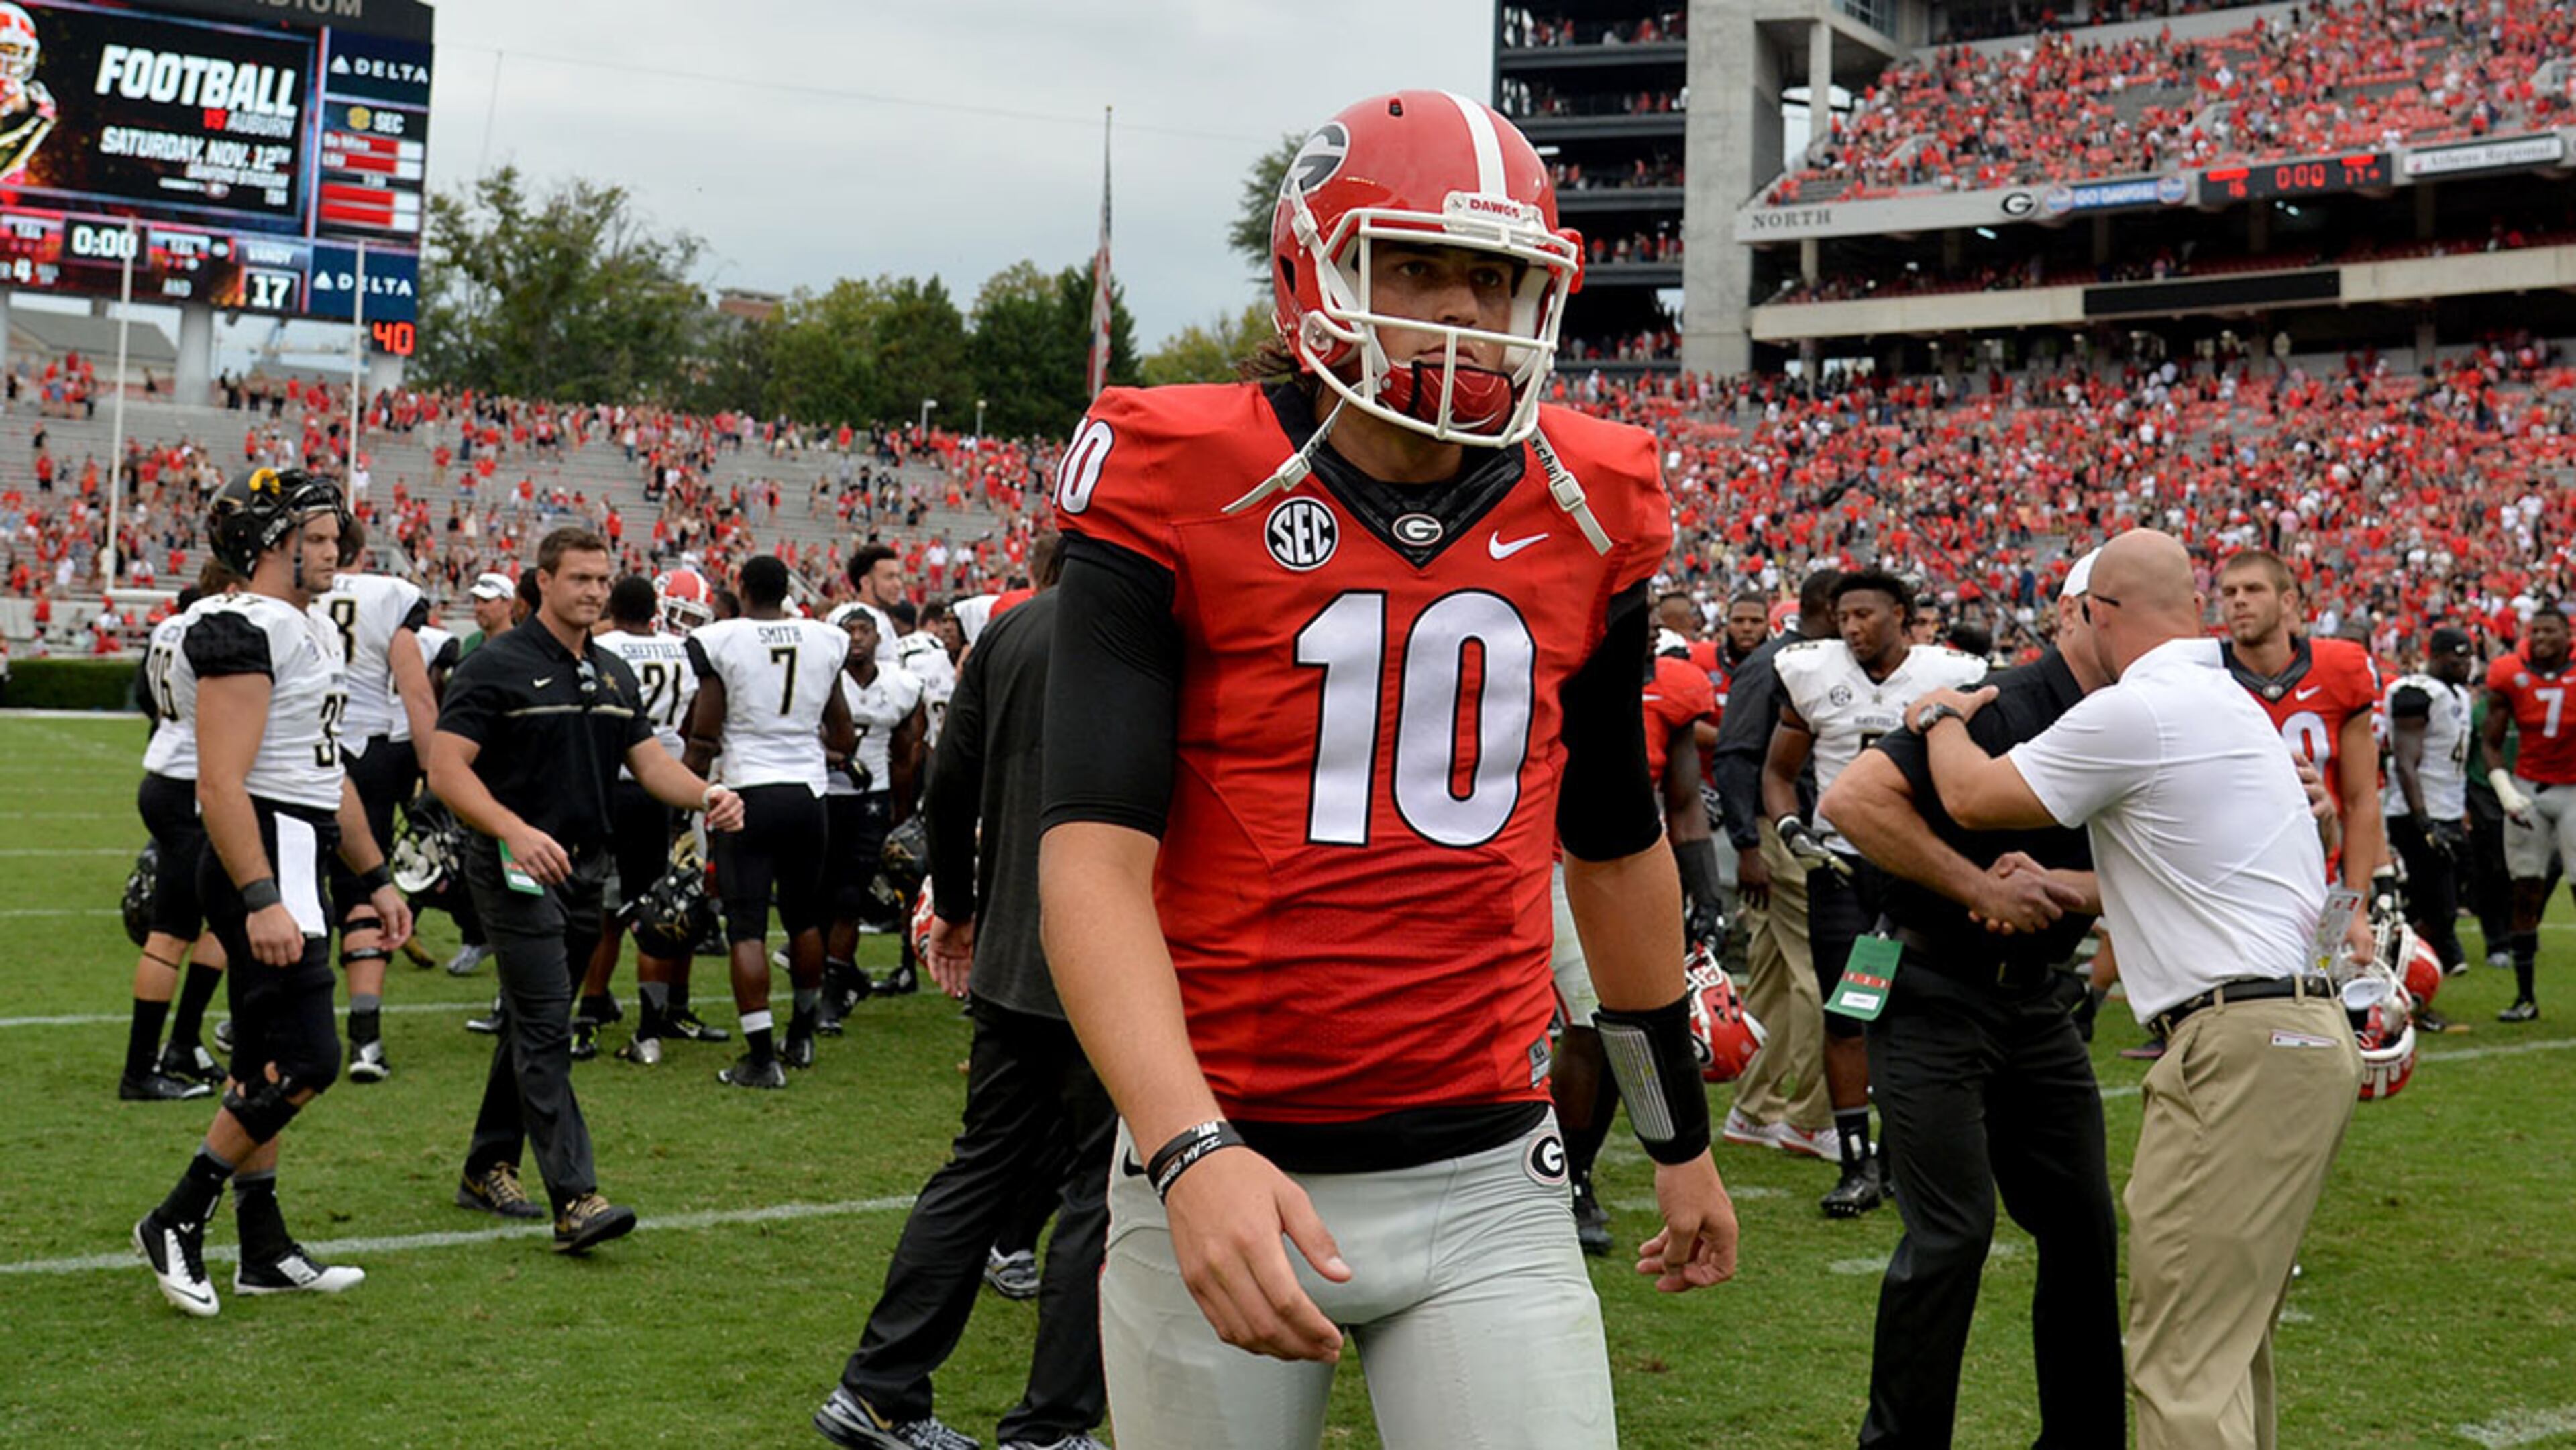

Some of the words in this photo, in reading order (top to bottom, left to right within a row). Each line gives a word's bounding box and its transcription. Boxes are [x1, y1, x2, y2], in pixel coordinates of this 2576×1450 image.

[95, 44, 297, 116] FOOTBALL
[354, 56, 428, 84] DELTA
[373, 111, 405, 134] SEC
[1470, 199, 1520, 219] DAWGS
[1752, 209, 1831, 229] NORTH
[72, 225, 138, 258] 0:00
[252, 274, 292, 309] 17
[373, 321, 416, 357] 40
[1532, 438, 1560, 478] schu
[1269, 501, 1334, 566] SEC
[758, 626, 803, 645] SMITH
[642, 661, 682, 726] 21
[770, 646, 797, 717] 7
[1294, 590, 1536, 848] 10
[2534, 688, 2564, 738] 7
[1530, 1135, 1566, 1179] G
